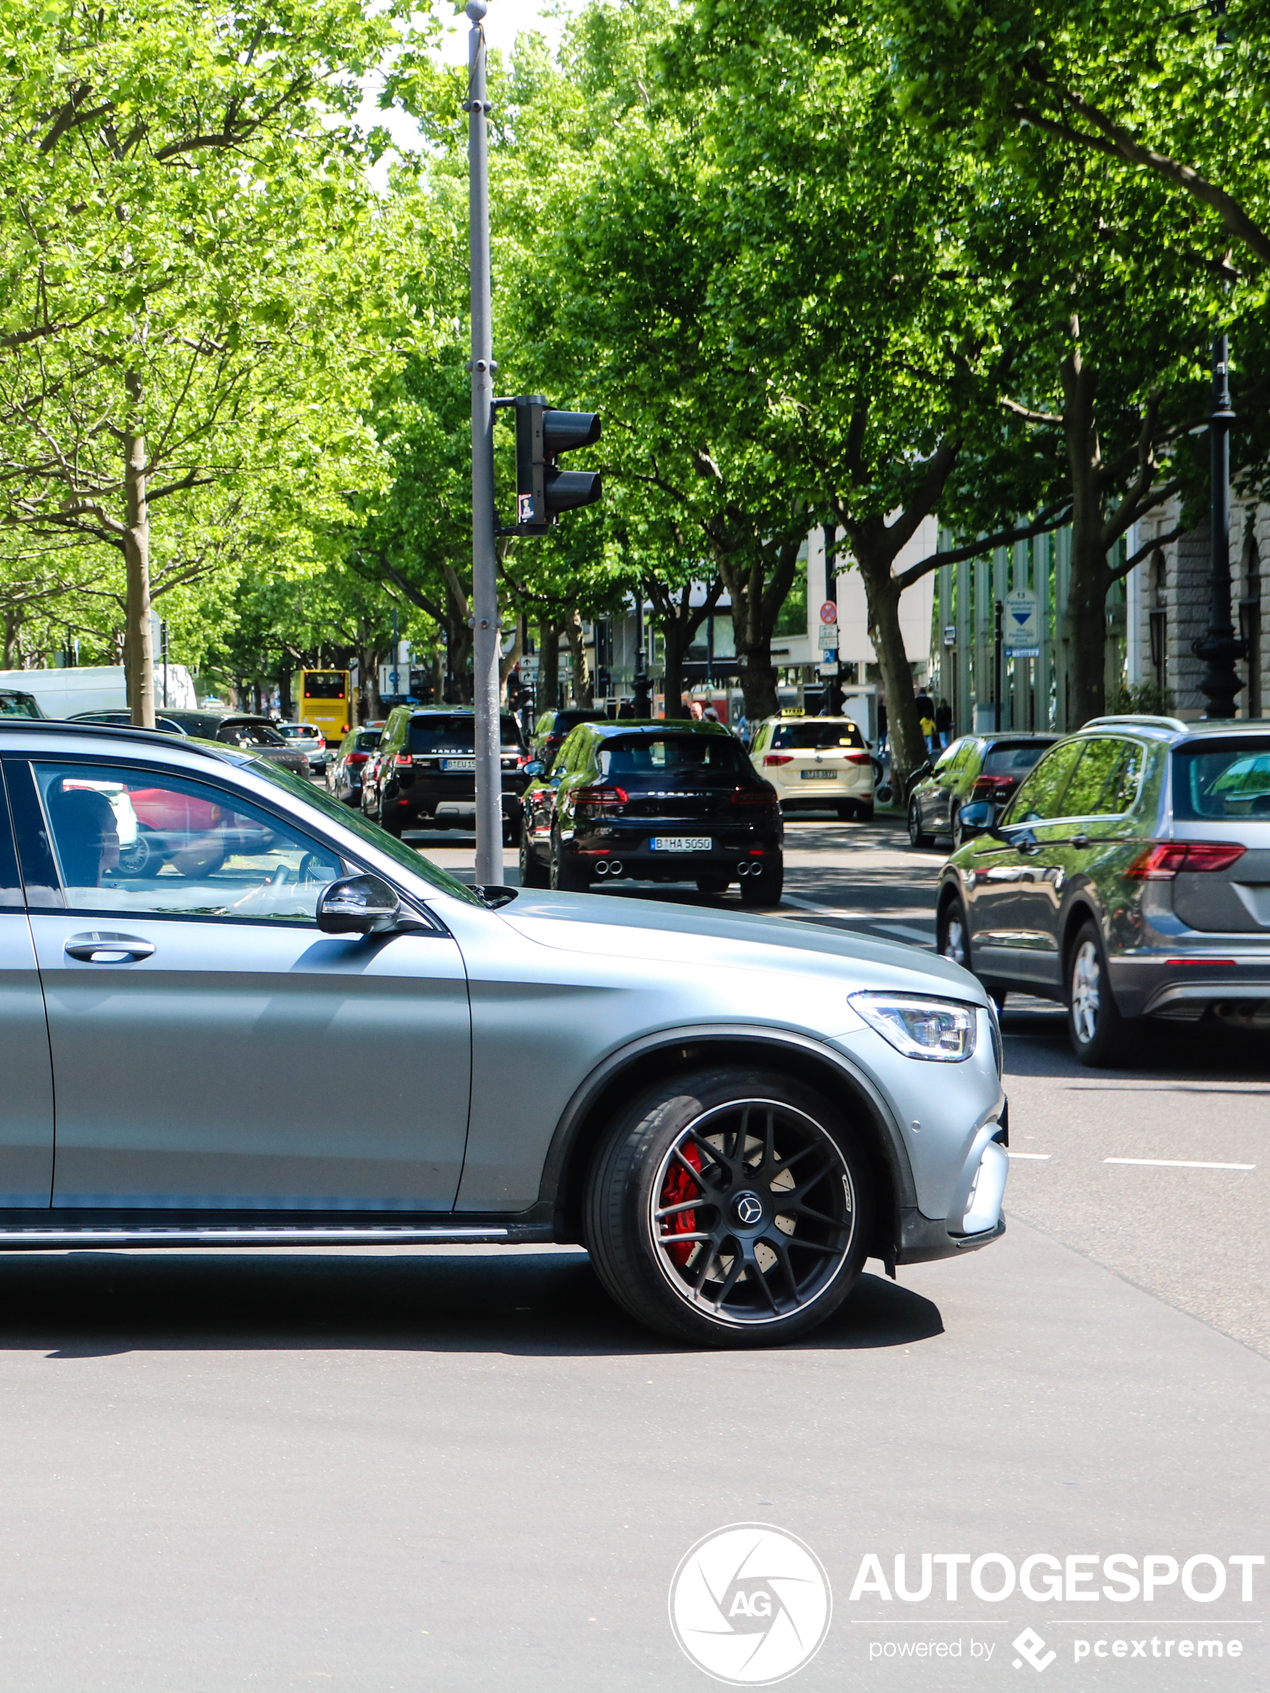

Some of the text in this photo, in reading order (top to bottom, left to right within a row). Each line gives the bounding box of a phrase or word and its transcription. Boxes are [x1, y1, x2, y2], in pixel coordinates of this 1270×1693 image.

[457, 760, 467, 768] EU
[656, 839, 710, 849] B HA 5050
